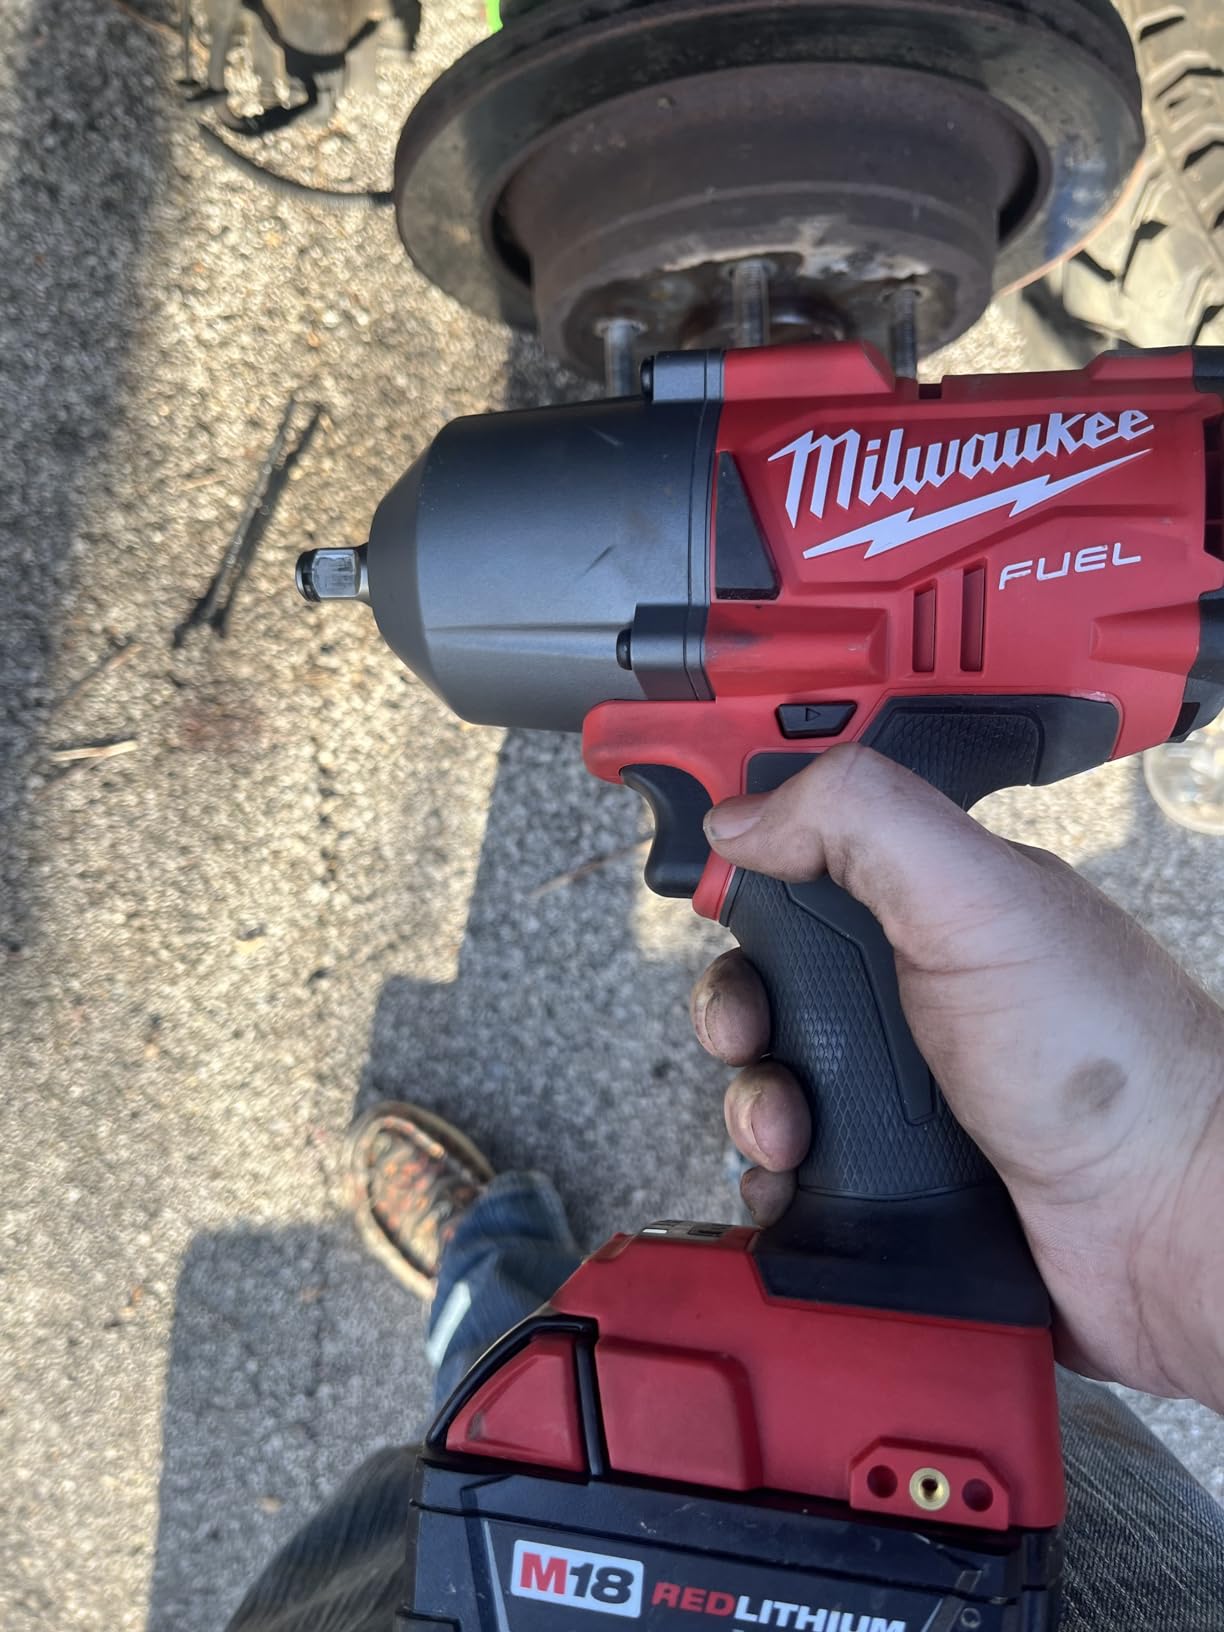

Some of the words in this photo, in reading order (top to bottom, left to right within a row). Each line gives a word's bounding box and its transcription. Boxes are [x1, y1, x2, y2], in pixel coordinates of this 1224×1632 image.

[768, 409, 1154, 528] Milwaukee
[998, 542, 1141, 590] FUEL
[520, 1551, 635, 1605] M18
